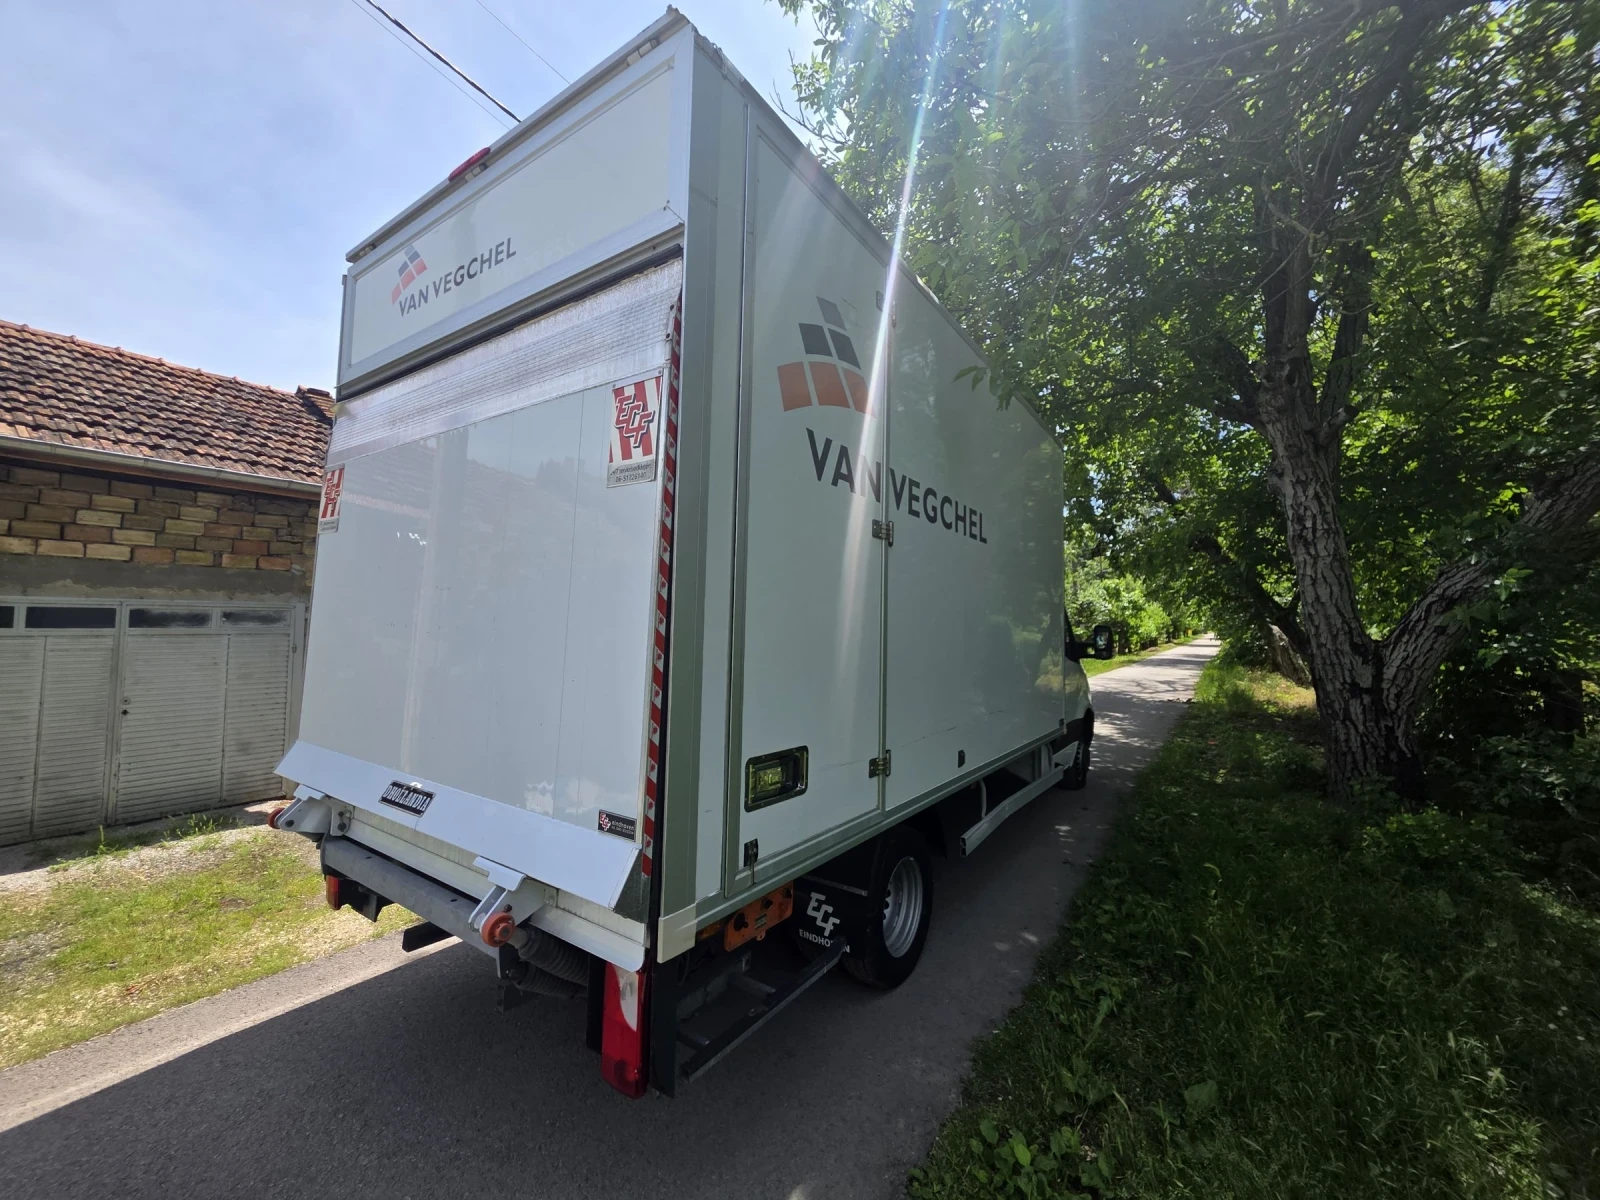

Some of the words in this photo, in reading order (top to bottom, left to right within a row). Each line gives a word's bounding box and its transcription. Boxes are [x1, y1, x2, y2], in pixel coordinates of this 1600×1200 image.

[398, 285, 429, 317] VAN
[432, 237, 517, 299] VEGCHEL
[806, 427, 881, 503] VAN
[889, 467, 987, 544] VEGCHEL
[382, 785, 431, 812] DHOLLANDIA
[806, 891, 841, 937] ECF
[799, 928, 850, 953] EINDHON
